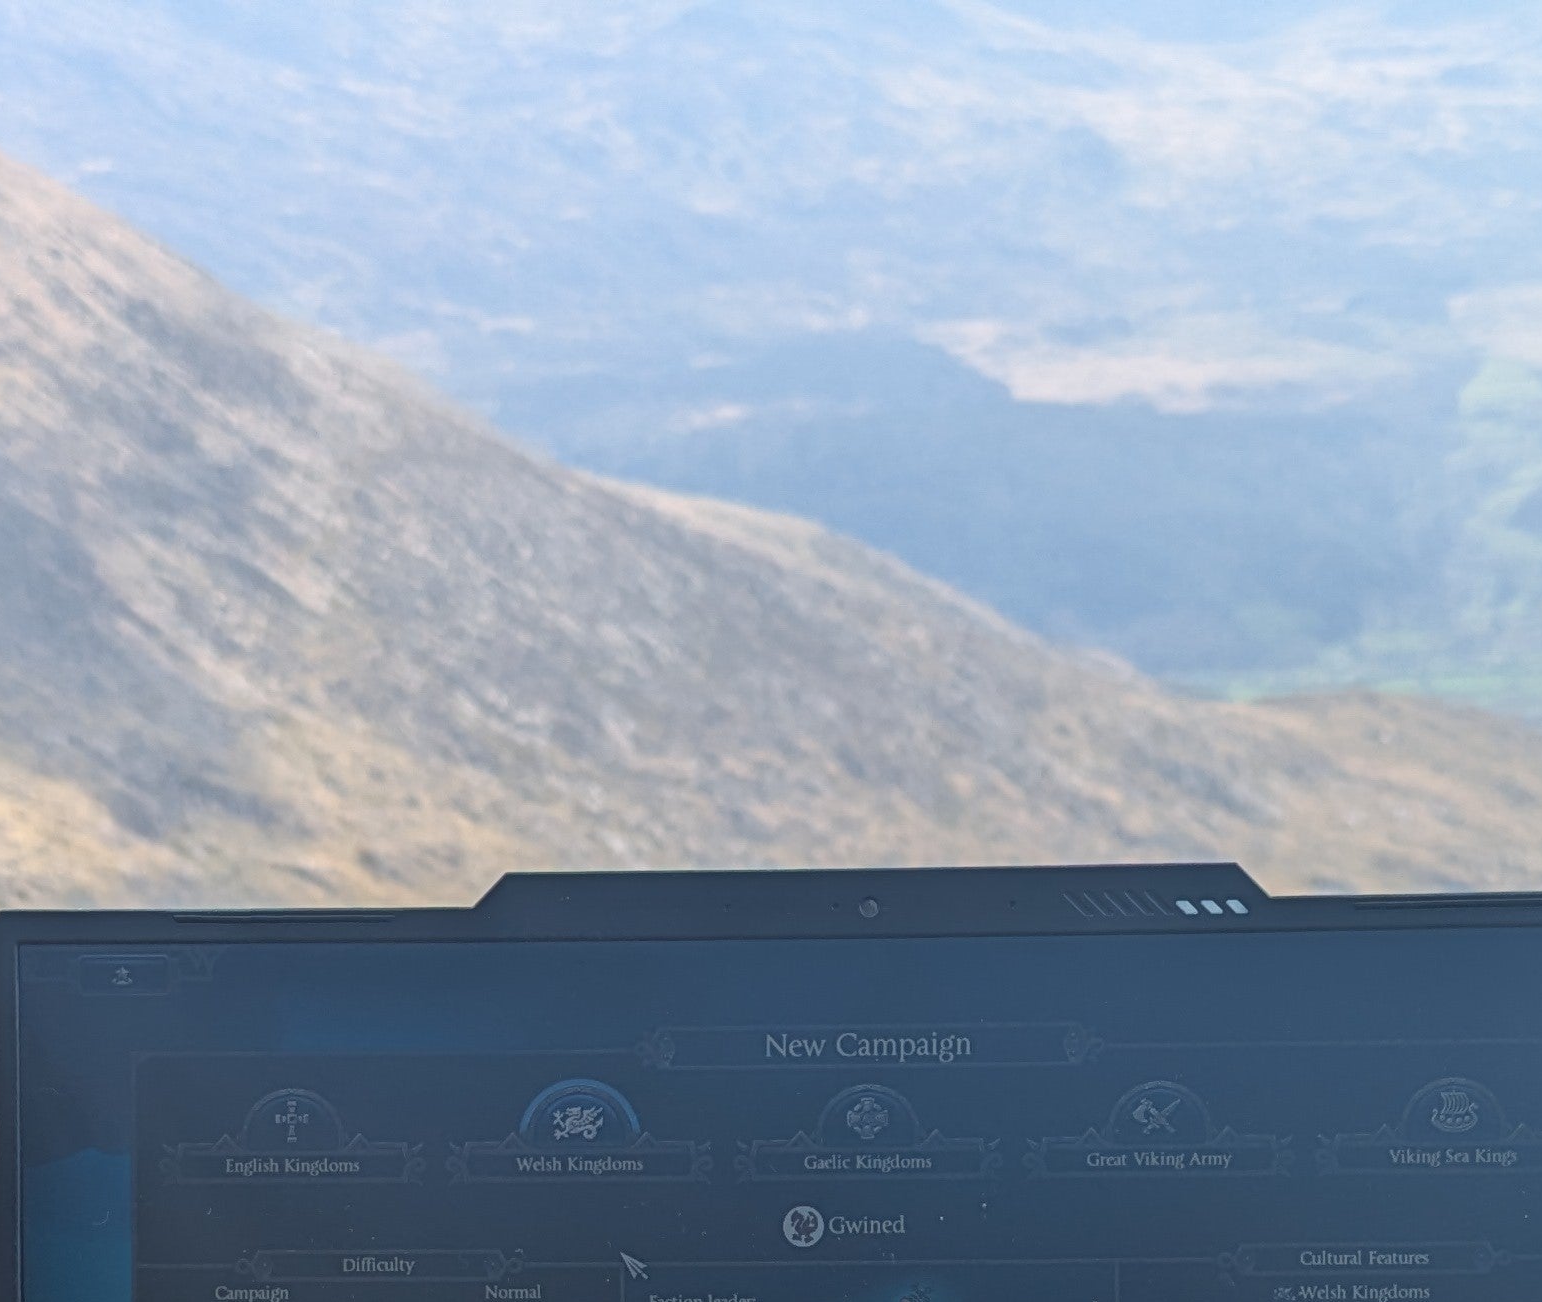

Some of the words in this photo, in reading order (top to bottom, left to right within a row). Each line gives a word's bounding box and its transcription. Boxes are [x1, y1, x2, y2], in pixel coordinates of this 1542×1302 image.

[765, 1033, 826, 1058] New
[836, 1031, 971, 1063] Campaign
[225, 1158, 279, 1177] English
[284, 1157, 360, 1177] Kingdoms
[516, 1156, 562, 1172] Welsh
[567, 1156, 644, 1175] Kingdoms
[803, 1154, 851, 1170] Gaelic
[856, 1154, 932, 1173] Kingdoms
[1086, 1152, 1127, 1167] Great
[1133, 1151, 1185, 1169] Viking
[1188, 1152, 1233, 1169] Army
[1389, 1148, 1441, 1168] Viking
[1445, 1148, 1470, 1163] Sea
[1475, 1148, 1517, 1167] Kings
[829, 1214, 906, 1235] Gwined
[343, 1256, 416, 1275] Difficulty
[1300, 1250, 1362, 1266] Cultural
[1368, 1250, 1430, 1265] Features
[485, 1284, 542, 1300] Normal
[1298, 1284, 1347, 1300] Welsh
[1352, 1284, 1431, 1302] Kingdoms
